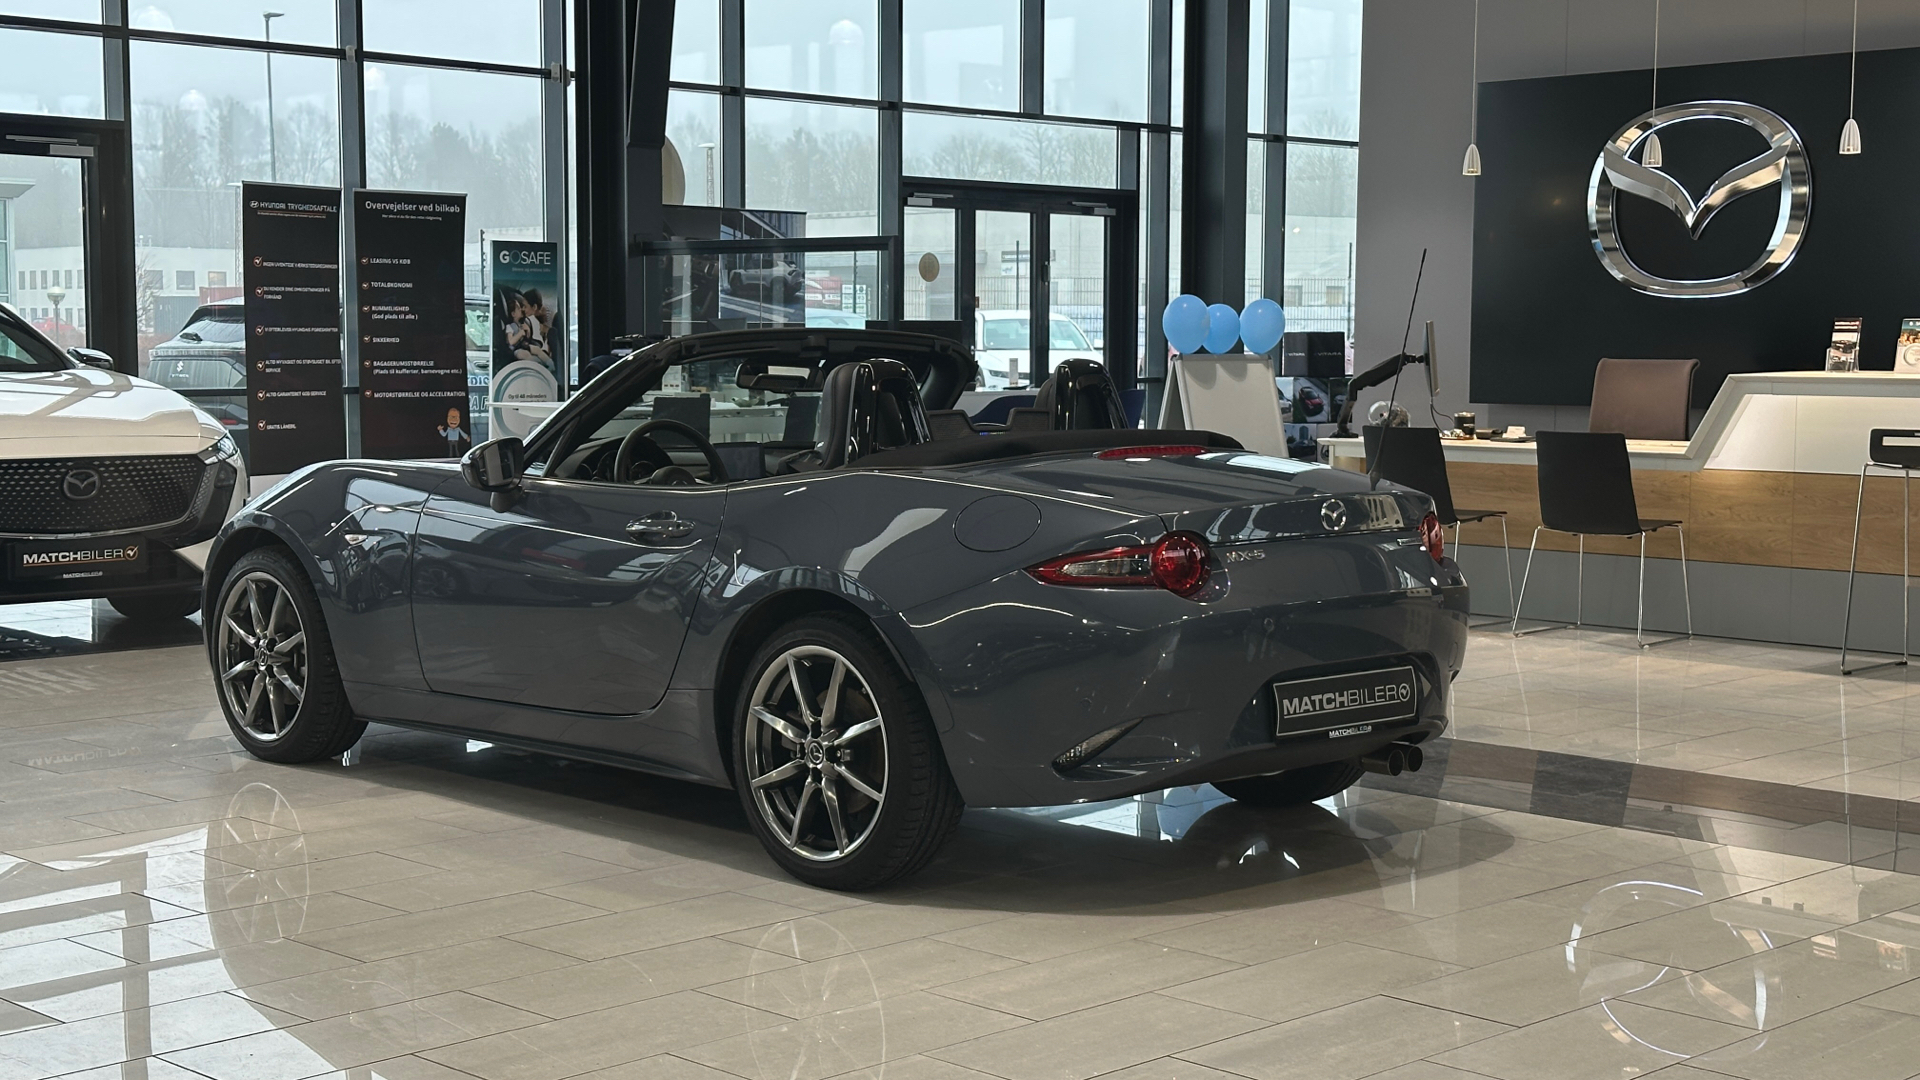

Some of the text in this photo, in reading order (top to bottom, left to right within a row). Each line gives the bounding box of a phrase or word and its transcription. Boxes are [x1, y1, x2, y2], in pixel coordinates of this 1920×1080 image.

[287, 203, 337, 213] TRYGHEDSAFTALE
[365, 200, 460, 213] Overvejelser ved bilkøb
[499, 250, 551, 264] GOSAFE
[23, 548, 124, 564] MATCHBILER
[1226, 549, 1266, 563] MX-5
[1282, 684, 1398, 715] MATCHBILER
[1329, 726, 1368, 738] MATCHBILER
